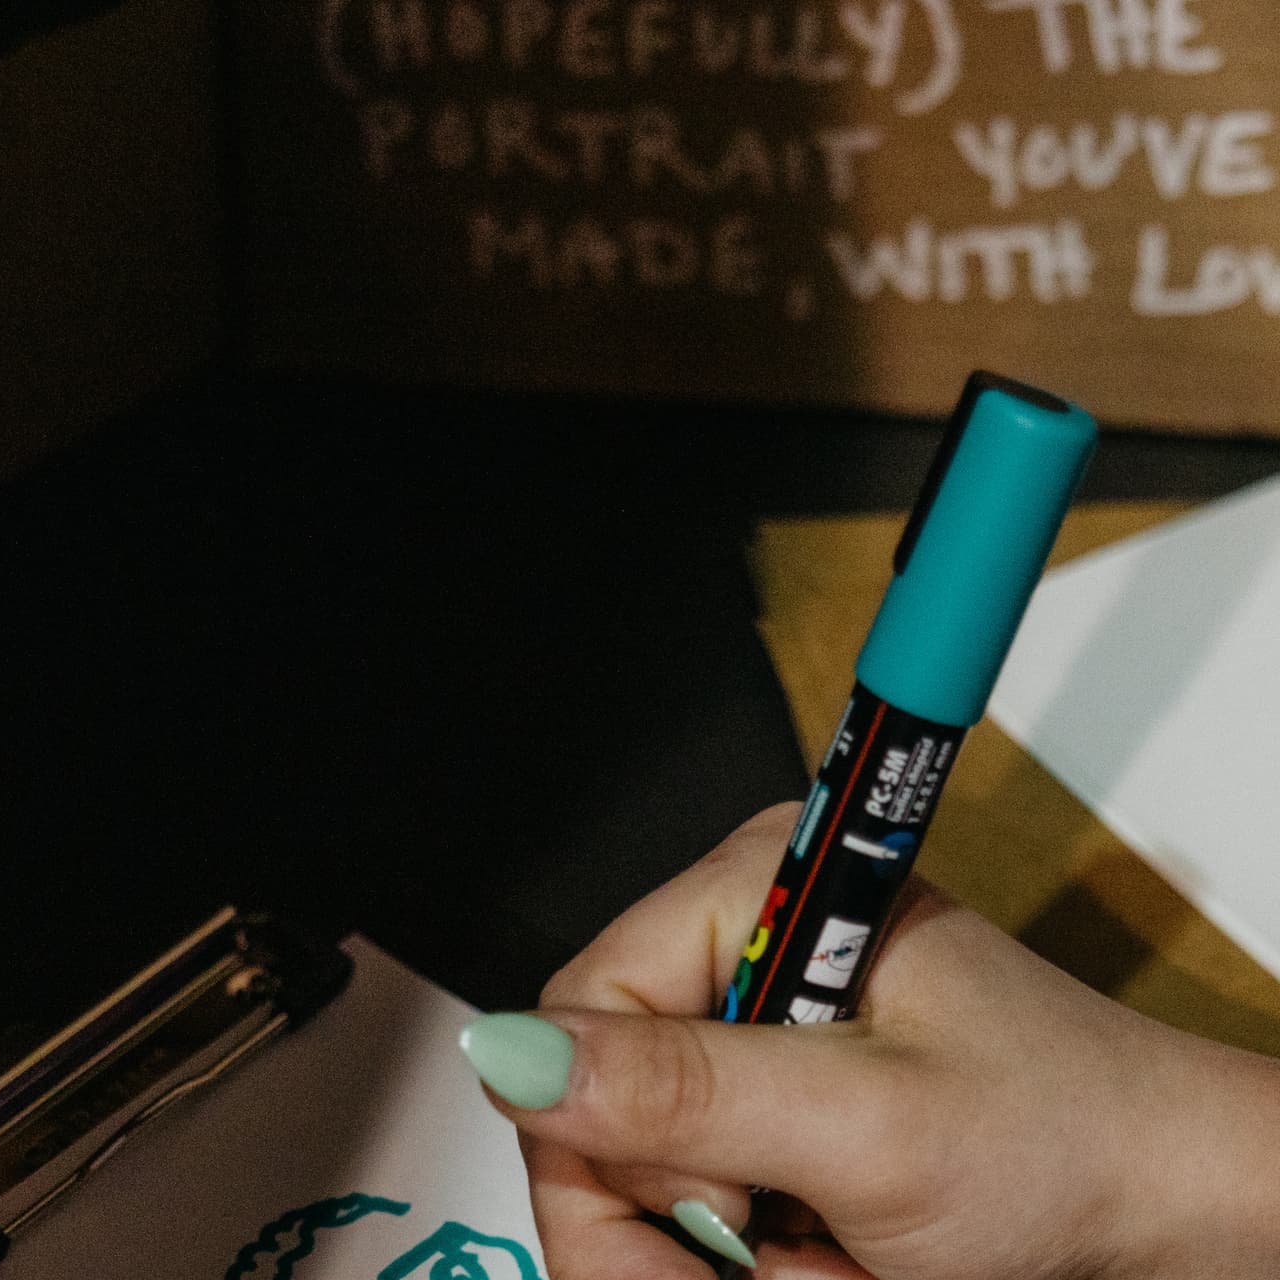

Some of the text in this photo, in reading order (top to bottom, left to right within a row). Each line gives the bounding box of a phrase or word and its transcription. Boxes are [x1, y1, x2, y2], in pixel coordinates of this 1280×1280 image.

[980, 0, 1226, 76] THE
[355, 100, 886, 202] PORTRAIT
[824, 218, 1096, 305] WITH
[864, 748, 908, 818] PC-5M
